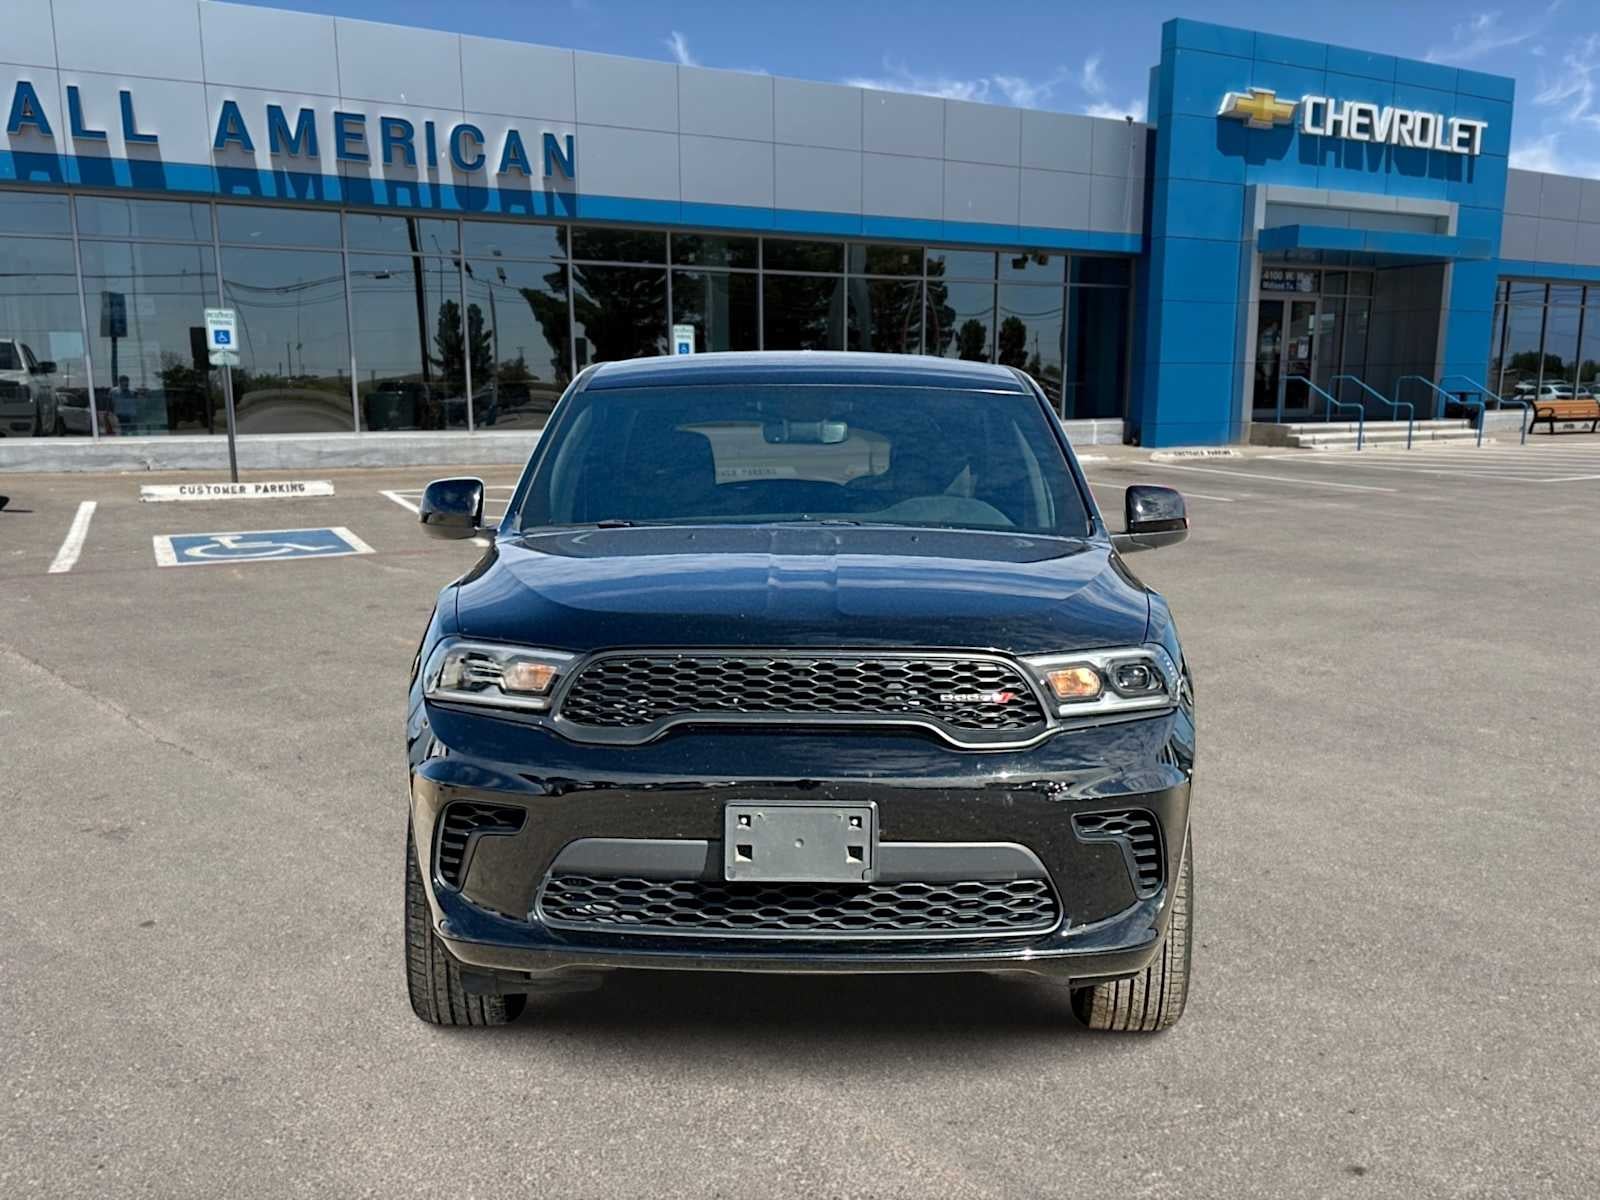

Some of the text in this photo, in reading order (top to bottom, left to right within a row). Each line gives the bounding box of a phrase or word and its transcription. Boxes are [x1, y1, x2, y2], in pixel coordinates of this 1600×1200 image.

[6, 80, 576, 180] ALL AMERICAN
[1301, 94, 1488, 155] CHEVROLET
[179, 483, 306, 495] CUSTOMER PARKING
